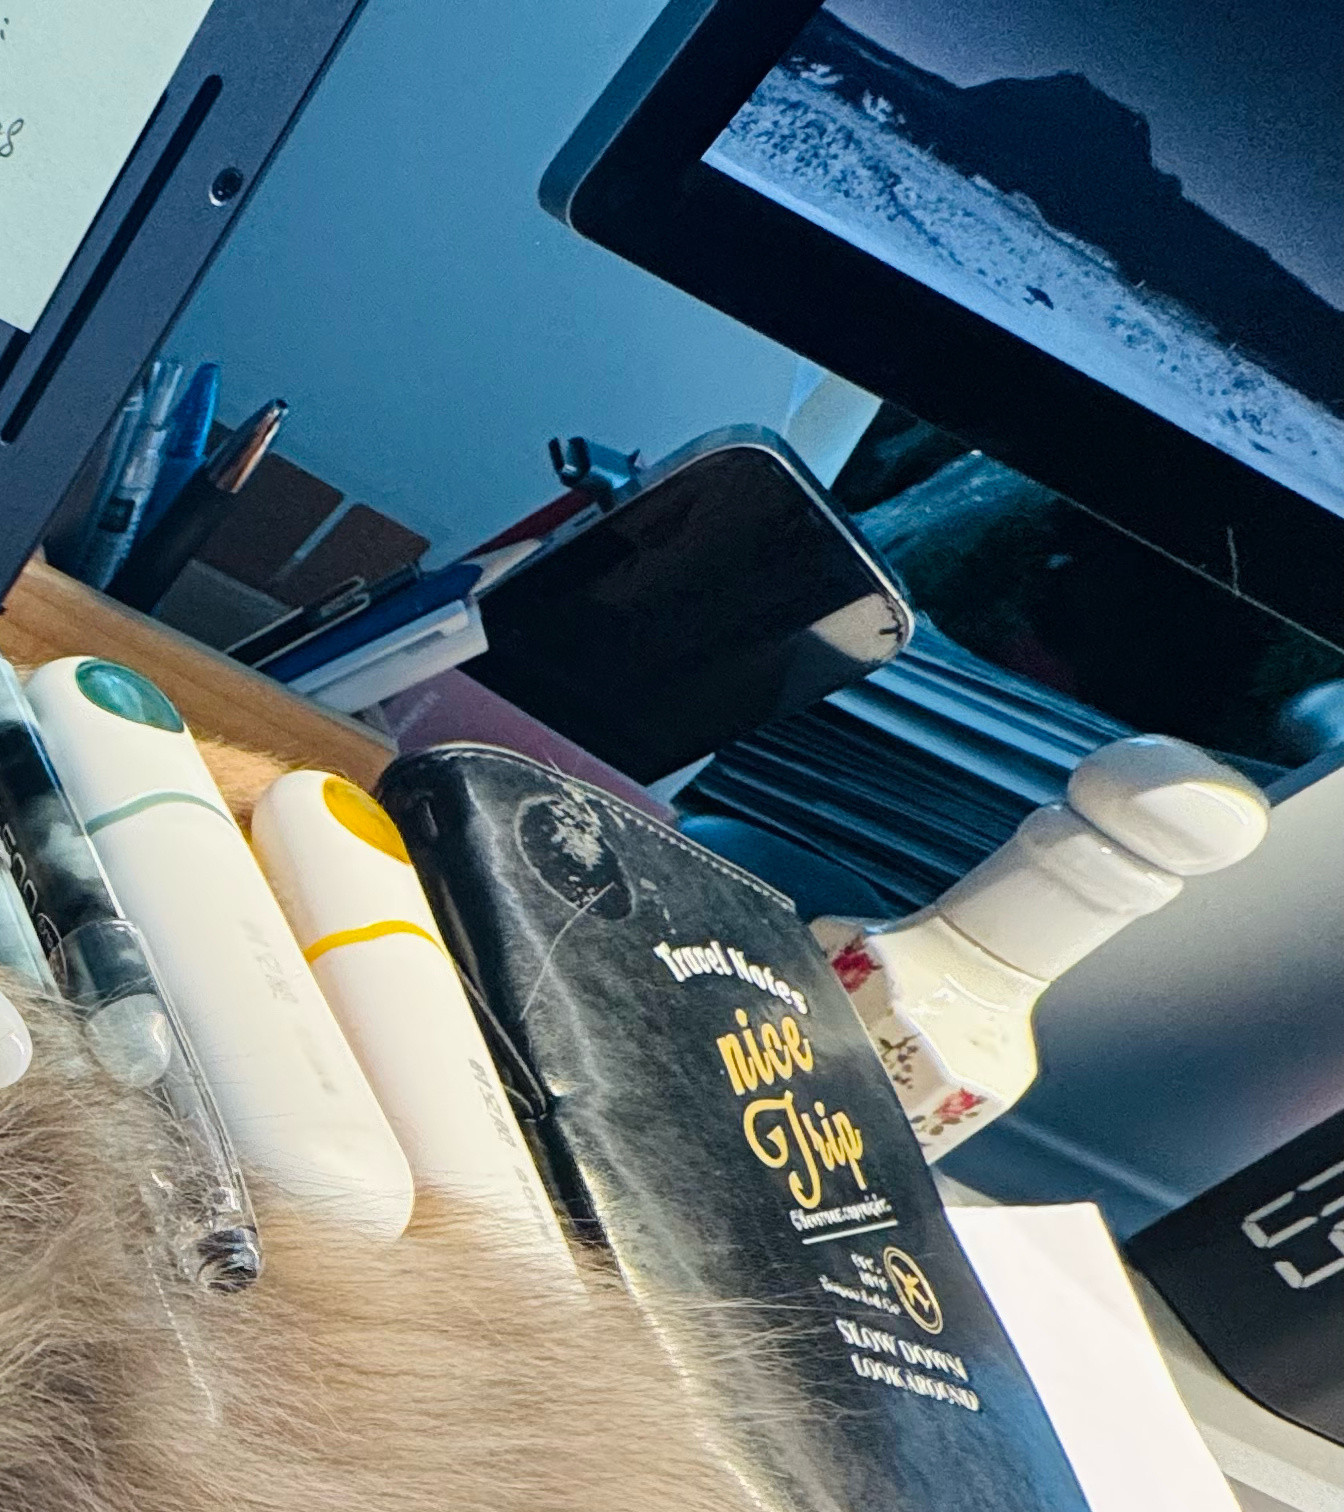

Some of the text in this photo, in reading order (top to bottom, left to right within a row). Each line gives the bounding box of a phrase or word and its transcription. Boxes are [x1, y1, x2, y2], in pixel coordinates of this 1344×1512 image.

[653, 940, 808, 1014] Travel Notes
[716, 1008, 813, 1096] nice
[743, 1090, 867, 1209] Trip
[897, 1338, 970, 1382] DOWN
